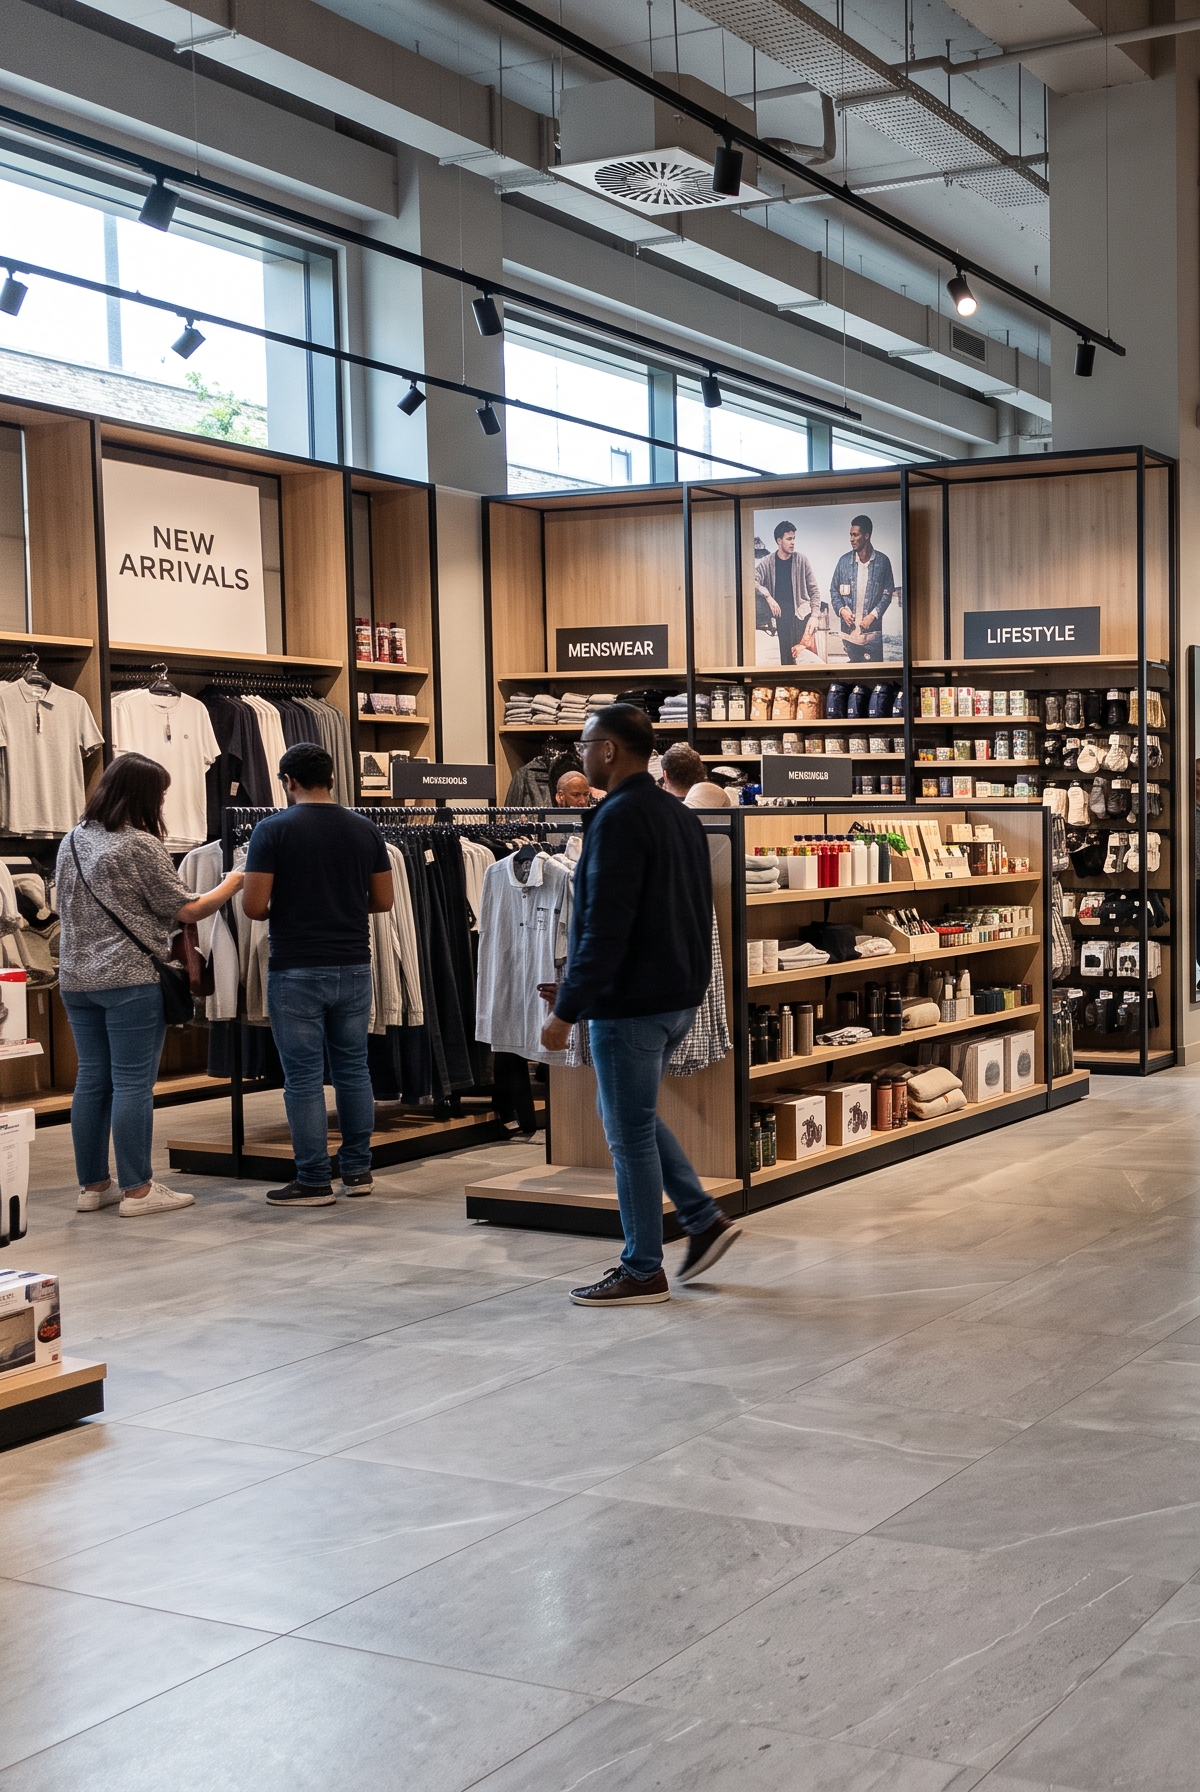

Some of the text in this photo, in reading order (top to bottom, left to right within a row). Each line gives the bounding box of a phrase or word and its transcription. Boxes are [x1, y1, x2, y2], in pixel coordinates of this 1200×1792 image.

[153, 525, 215, 556] NEW
[118, 552, 250, 591] ARRIVALS
[987, 625, 1076, 644] LIFESTYLE
[568, 640, 654, 658] MENSWEAR
